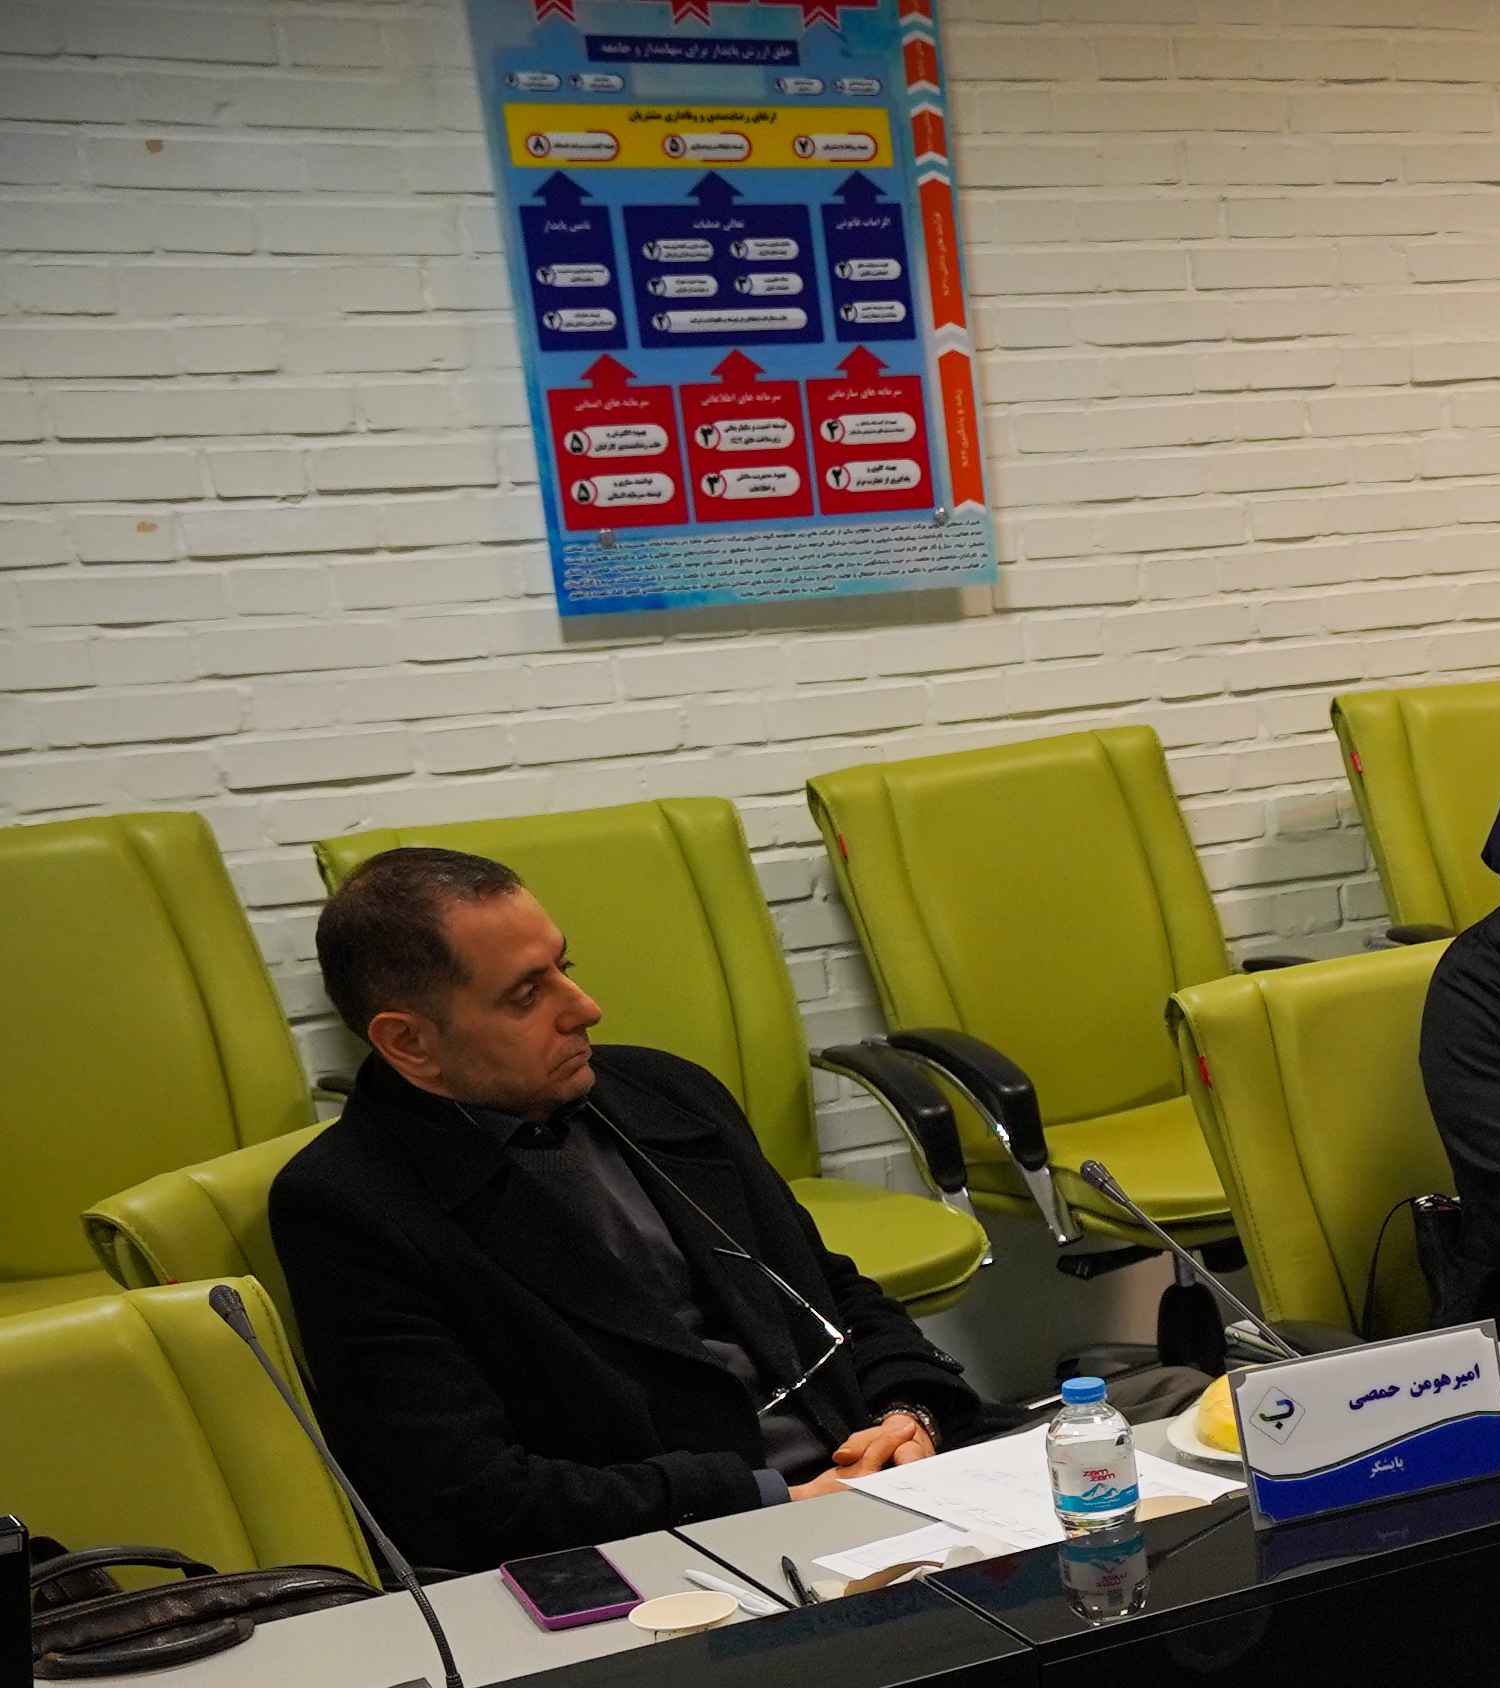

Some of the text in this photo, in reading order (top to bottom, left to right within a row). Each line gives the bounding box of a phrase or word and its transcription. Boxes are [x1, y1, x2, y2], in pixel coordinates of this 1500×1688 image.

[570, 433, 583, 451] ۵
[577, 483, 590, 502] ۵
[1349, 1363, 1480, 1410] امیرهومن حمصی
[1259, 1397, 1296, 1430] ب
